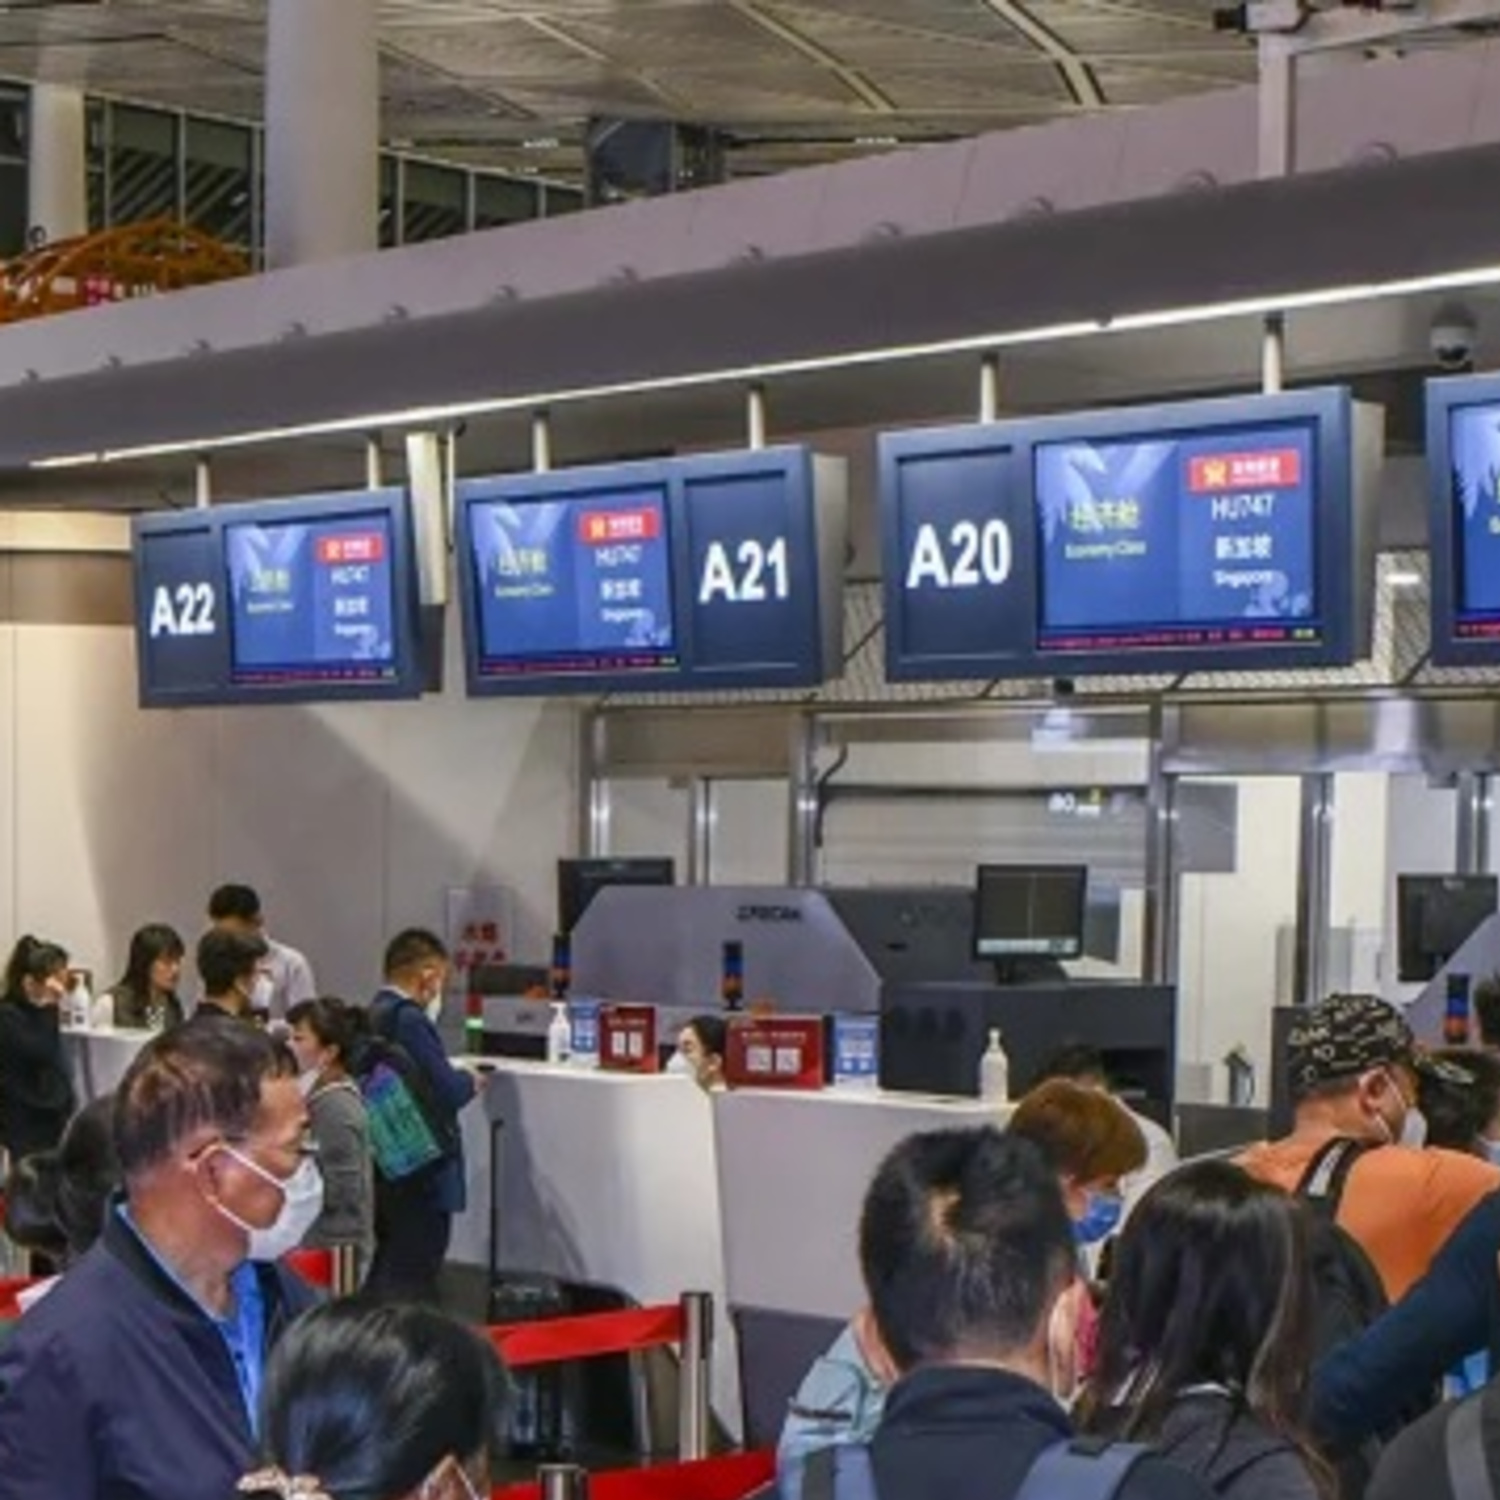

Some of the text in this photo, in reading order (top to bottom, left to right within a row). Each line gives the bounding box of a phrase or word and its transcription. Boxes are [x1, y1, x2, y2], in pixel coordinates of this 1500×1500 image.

[699, 537, 789, 604] A21
[905, 519, 1013, 588] A20
[150, 582, 215, 637] A22
